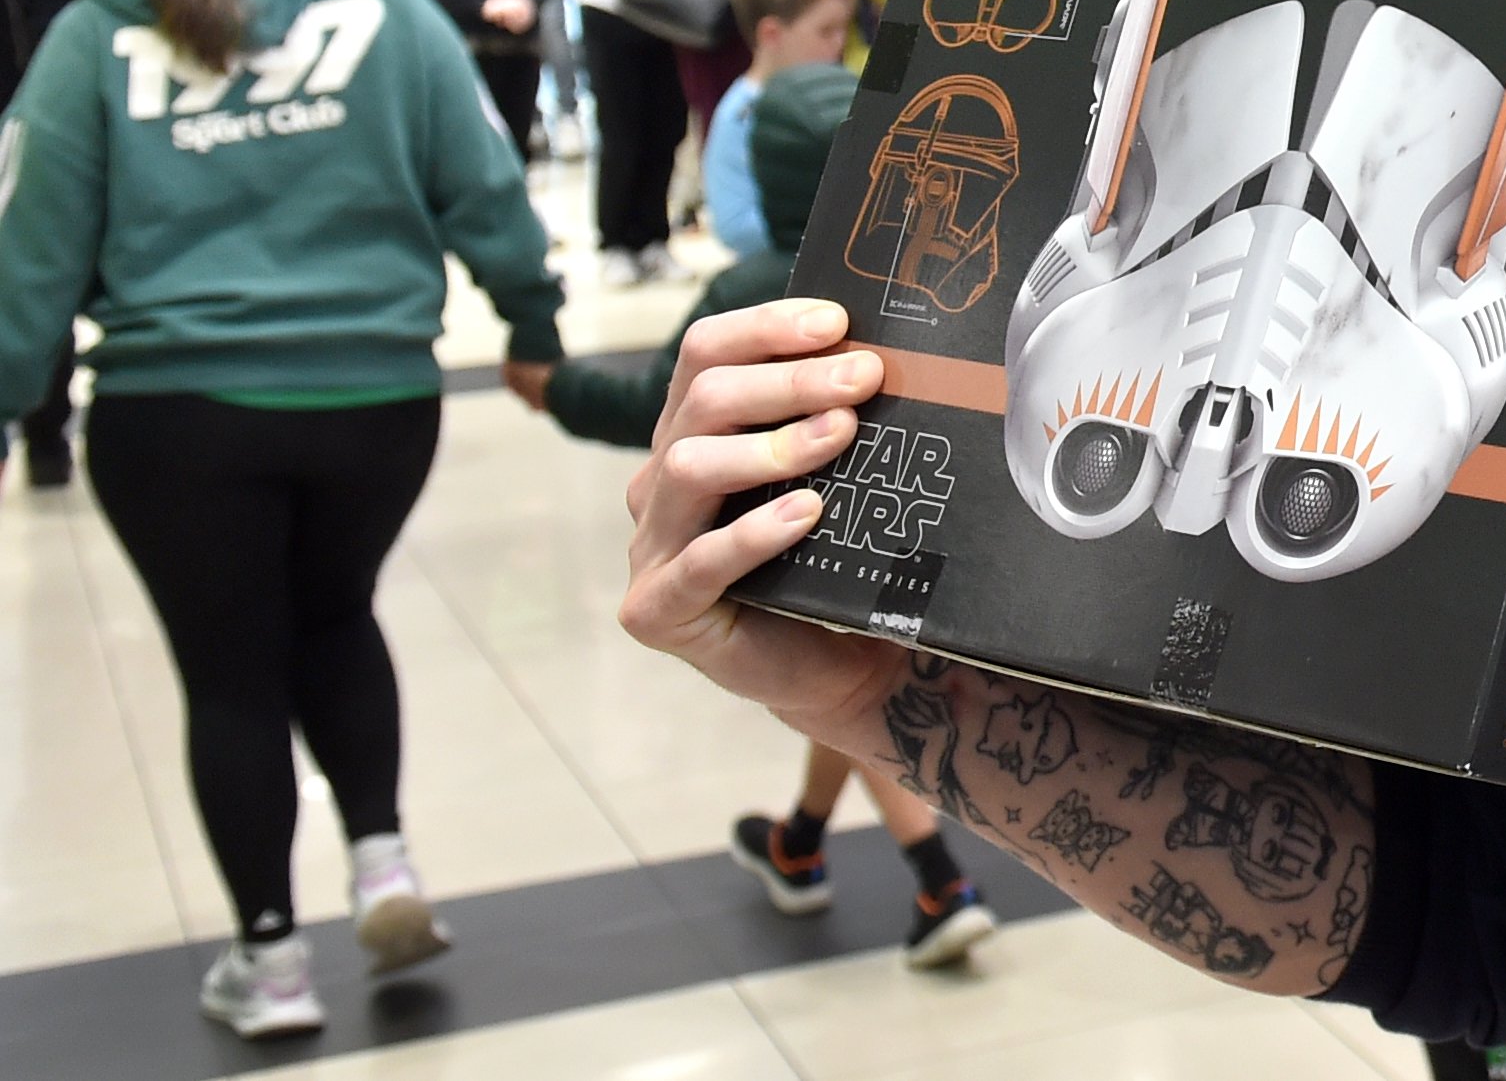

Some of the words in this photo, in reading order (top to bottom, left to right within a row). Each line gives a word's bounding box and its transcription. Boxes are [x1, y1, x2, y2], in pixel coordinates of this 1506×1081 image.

[266, 96, 347, 136] Club
[833, 420, 956, 499] TAR
[768, 476, 946, 559] ARS
[856, 566, 932, 593] SERIES
